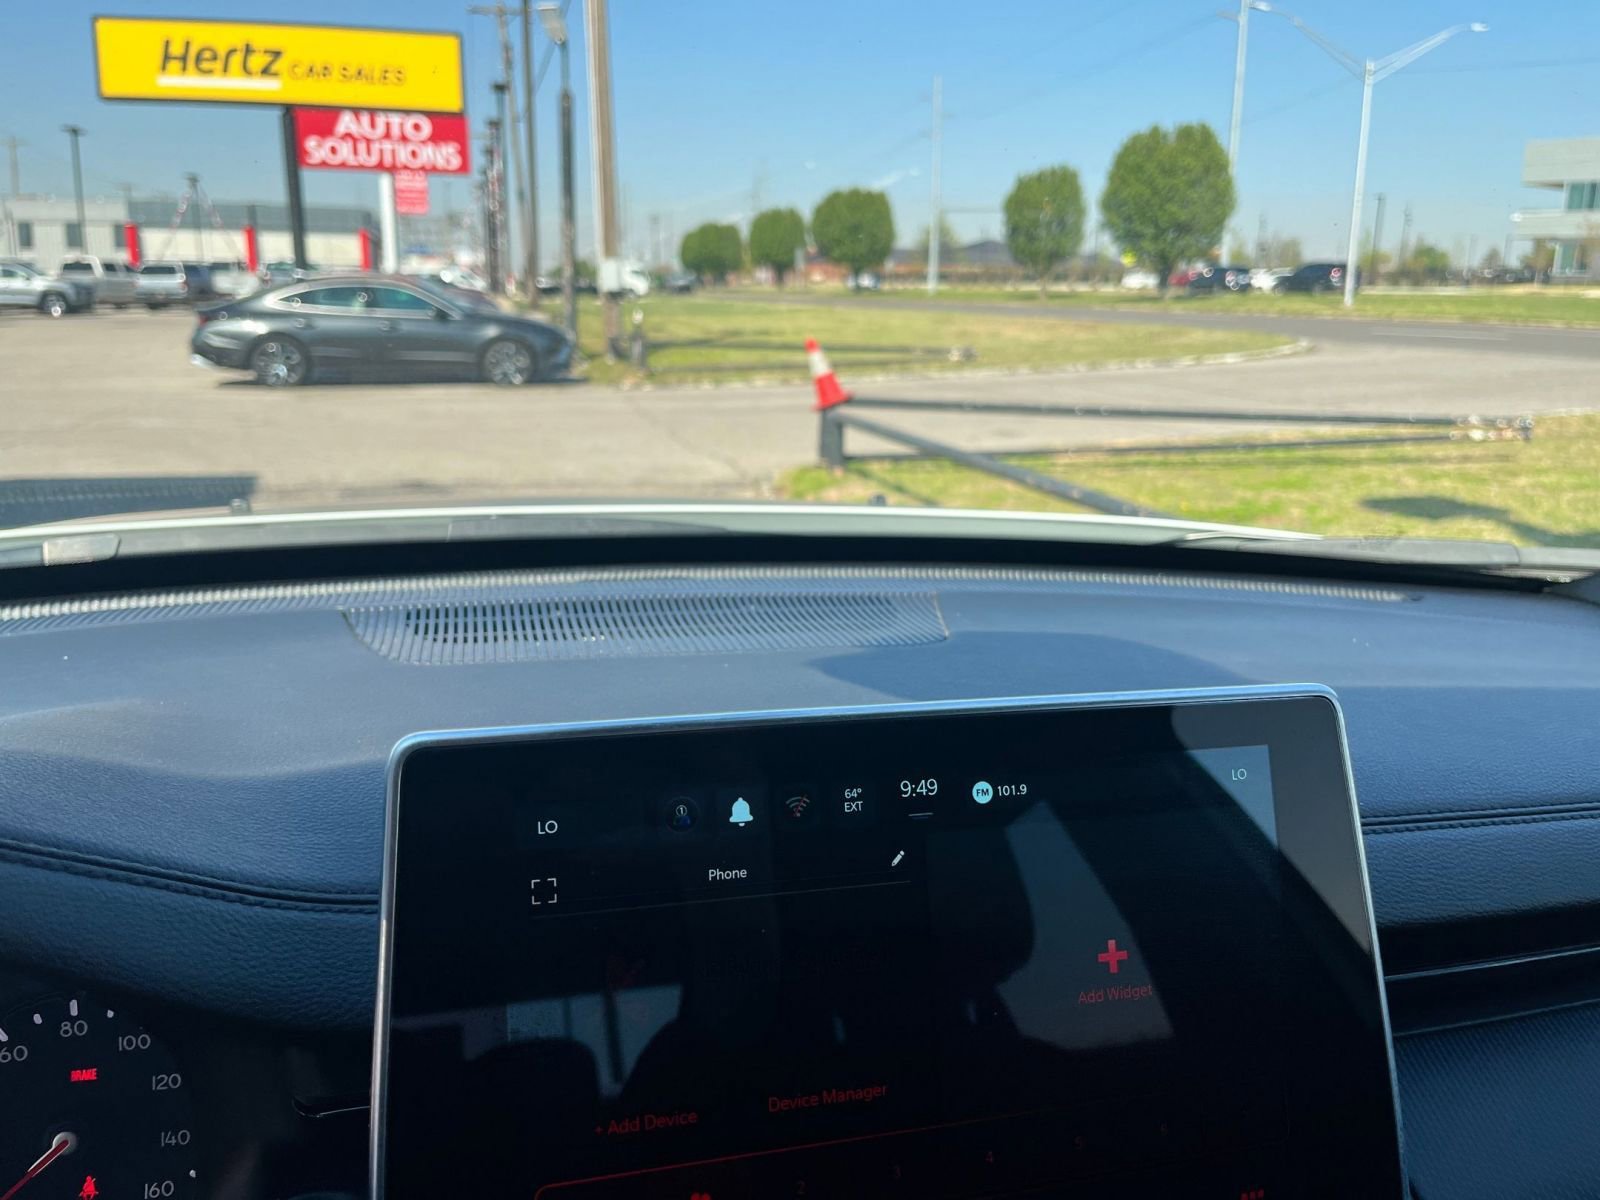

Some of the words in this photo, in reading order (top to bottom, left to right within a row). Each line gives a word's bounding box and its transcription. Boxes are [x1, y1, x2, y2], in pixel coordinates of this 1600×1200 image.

[160, 39, 284, 77] Hertz
[288, 62, 333, 83] CAR
[338, 63, 407, 87] SALES
[335, 110, 433, 141] AUTO
[304, 138, 462, 170] SOLUTIONS
[899, 778, 939, 798] 9:49
[975, 788, 990, 798] FM
[997, 784, 1028, 798] 101.9
[843, 800, 864, 813] EXT
[537, 819, 559, 835] LO
[707, 867, 748, 882] Phone
[1078, 988, 1105, 1005] Add
[1107, 983, 1153, 1001] Widget
[59, 1020, 89, 1038] 80
[118, 1034, 152, 1052] 100
[0, 1045, 29, 1064] 60
[70, 1068, 98, 1082] BRAKE
[151, 1073, 182, 1091] 120
[767, 1093, 819, 1113] Device
[821, 1084, 888, 1106] Manager
[607, 1117, 641, 1135] Add
[643, 1110, 699, 1131] Device
[160, 1129, 191, 1147] 140
[143, 1180, 175, 1199] 160
